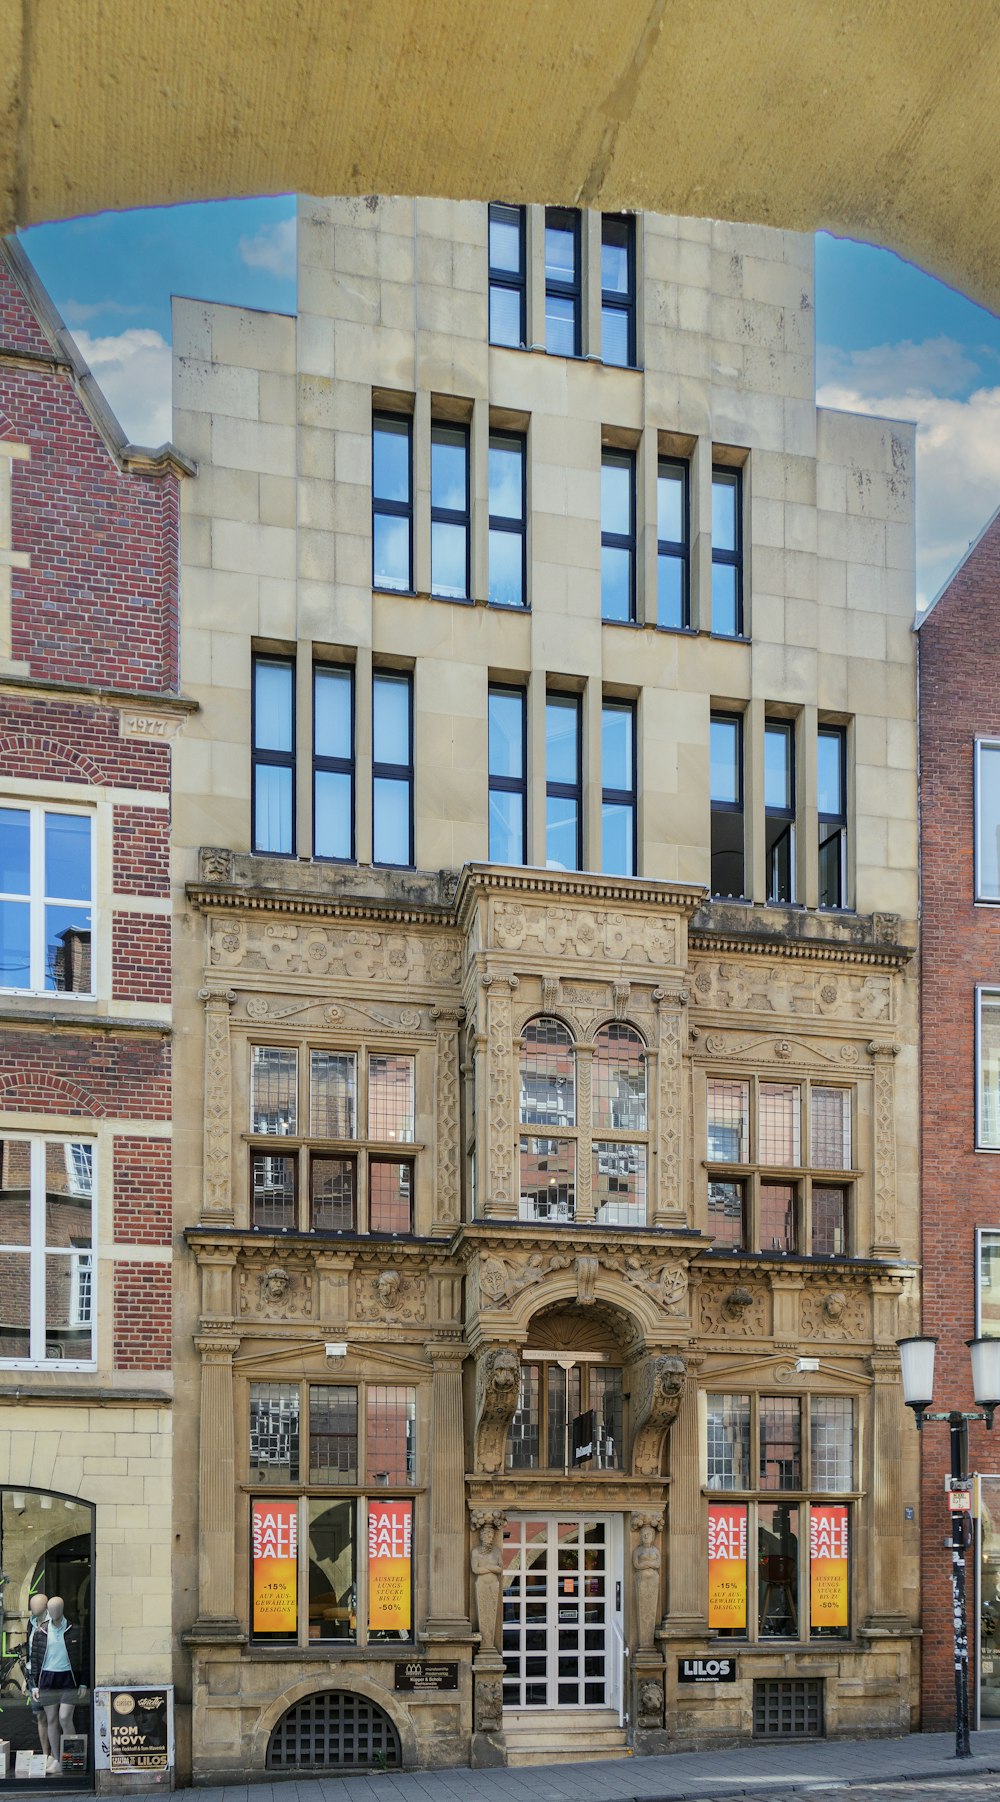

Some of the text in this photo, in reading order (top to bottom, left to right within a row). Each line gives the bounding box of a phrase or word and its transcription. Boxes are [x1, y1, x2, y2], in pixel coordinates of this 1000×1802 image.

[127, 717, 167, 736] 1977
[254, 1513, 297, 1528] SALE
[369, 1513, 411, 1528] SALE
[708, 1517, 747, 1531] SALE
[811, 1517, 848, 1531] SALE
[254, 1528, 297, 1543] SALE
[369, 1528, 411, 1543] SALE
[708, 1531, 747, 1545] SALE
[811, 1531, 848, 1545] SALE
[254, 1543, 297, 1558] SALE
[369, 1543, 411, 1558] SALE
[708, 1545, 747, 1559] SALE
[811, 1545, 848, 1558] SALE
[684, 1660, 730, 1675] LILOS
[112, 1726, 138, 1735] TOM
[112, 1735, 146, 1745] NOVY
[138, 1756, 167, 1766] LILOS
